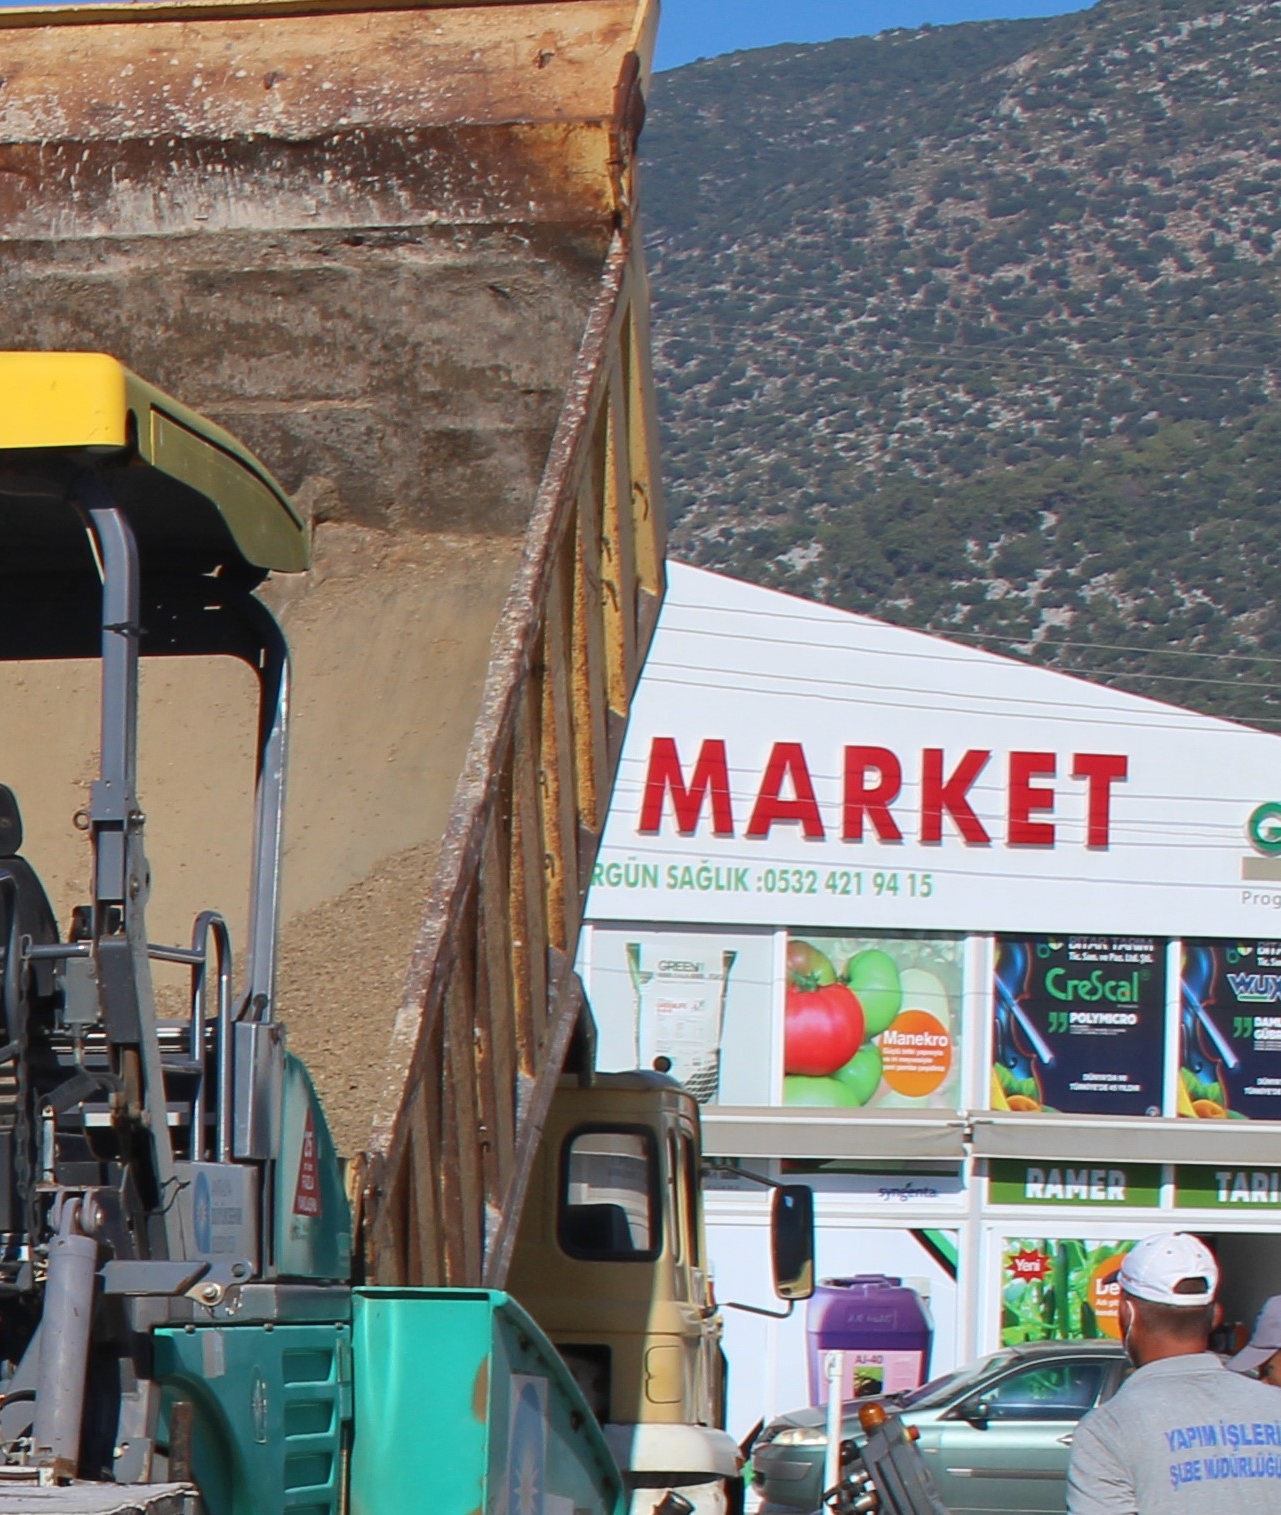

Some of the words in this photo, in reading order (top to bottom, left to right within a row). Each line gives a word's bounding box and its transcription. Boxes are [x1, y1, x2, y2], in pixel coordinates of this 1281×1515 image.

[638, 737, 1129, 851] MARKET
[666, 859, 751, 892] SAĞLIK
[756, 869, 818, 895] :0532
[825, 871, 863, 896] 421
[873, 872, 899, 897] 94
[908, 873, 933, 898] 15
[1045, 967, 1139, 1002] CreScal
[1069, 1012, 1138, 1025] POLYMICRO
[883, 1030, 948, 1047] Manekro
[877, 1182, 937, 1201] syngenta
[1025, 1168, 1126, 1200] RAMER
[1014, 1258, 1041, 1272] Yeni
[1163, 1425, 1217, 1452] YAPIM
[1169, 1460, 1201, 1492] ŞUBE
